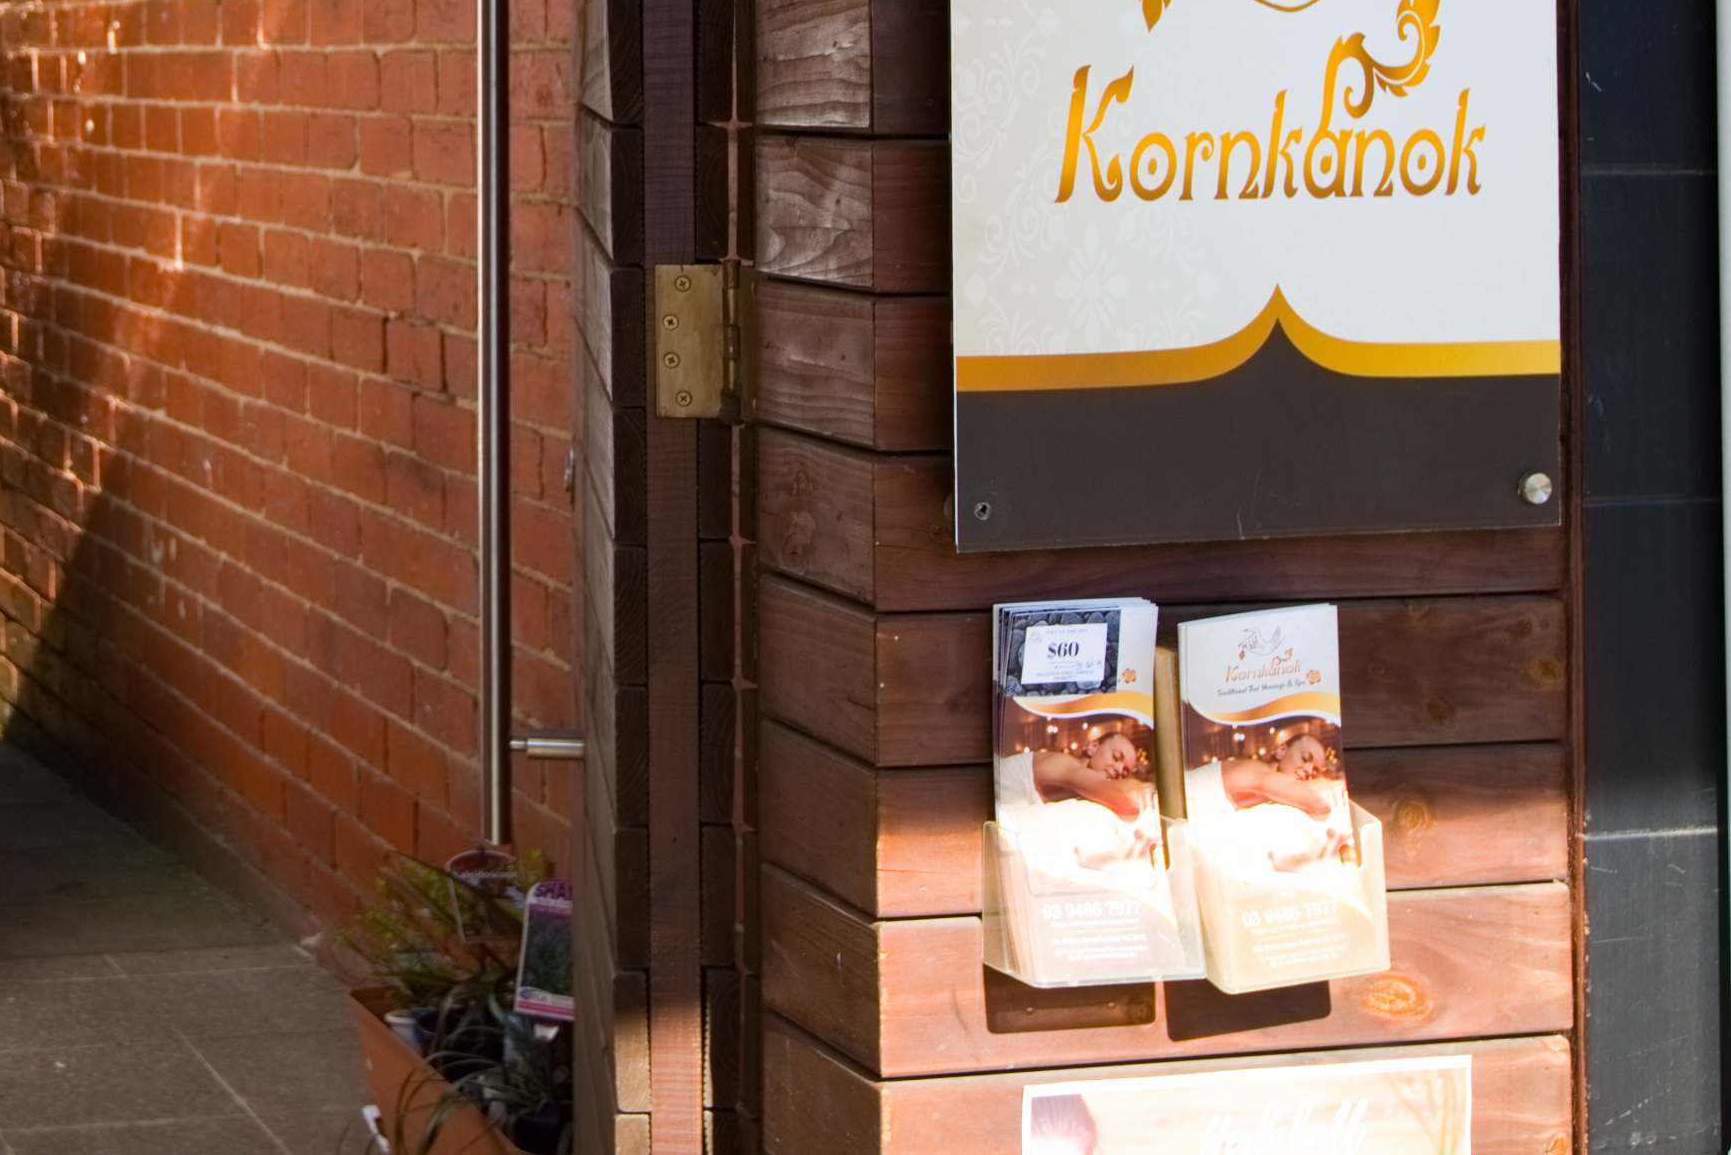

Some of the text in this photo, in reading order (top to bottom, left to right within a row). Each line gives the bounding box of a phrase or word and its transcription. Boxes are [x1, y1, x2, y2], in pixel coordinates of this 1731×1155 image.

[1048, 641, 1080, 659] $60
[1225, 648, 1301, 682] Kornkanok
[534, 880, 573, 901] SHA
[1042, 899, 1141, 919] 03 9486 7977
[1241, 911, 1260, 927] 03
[1263, 905, 1300, 923] 9486
